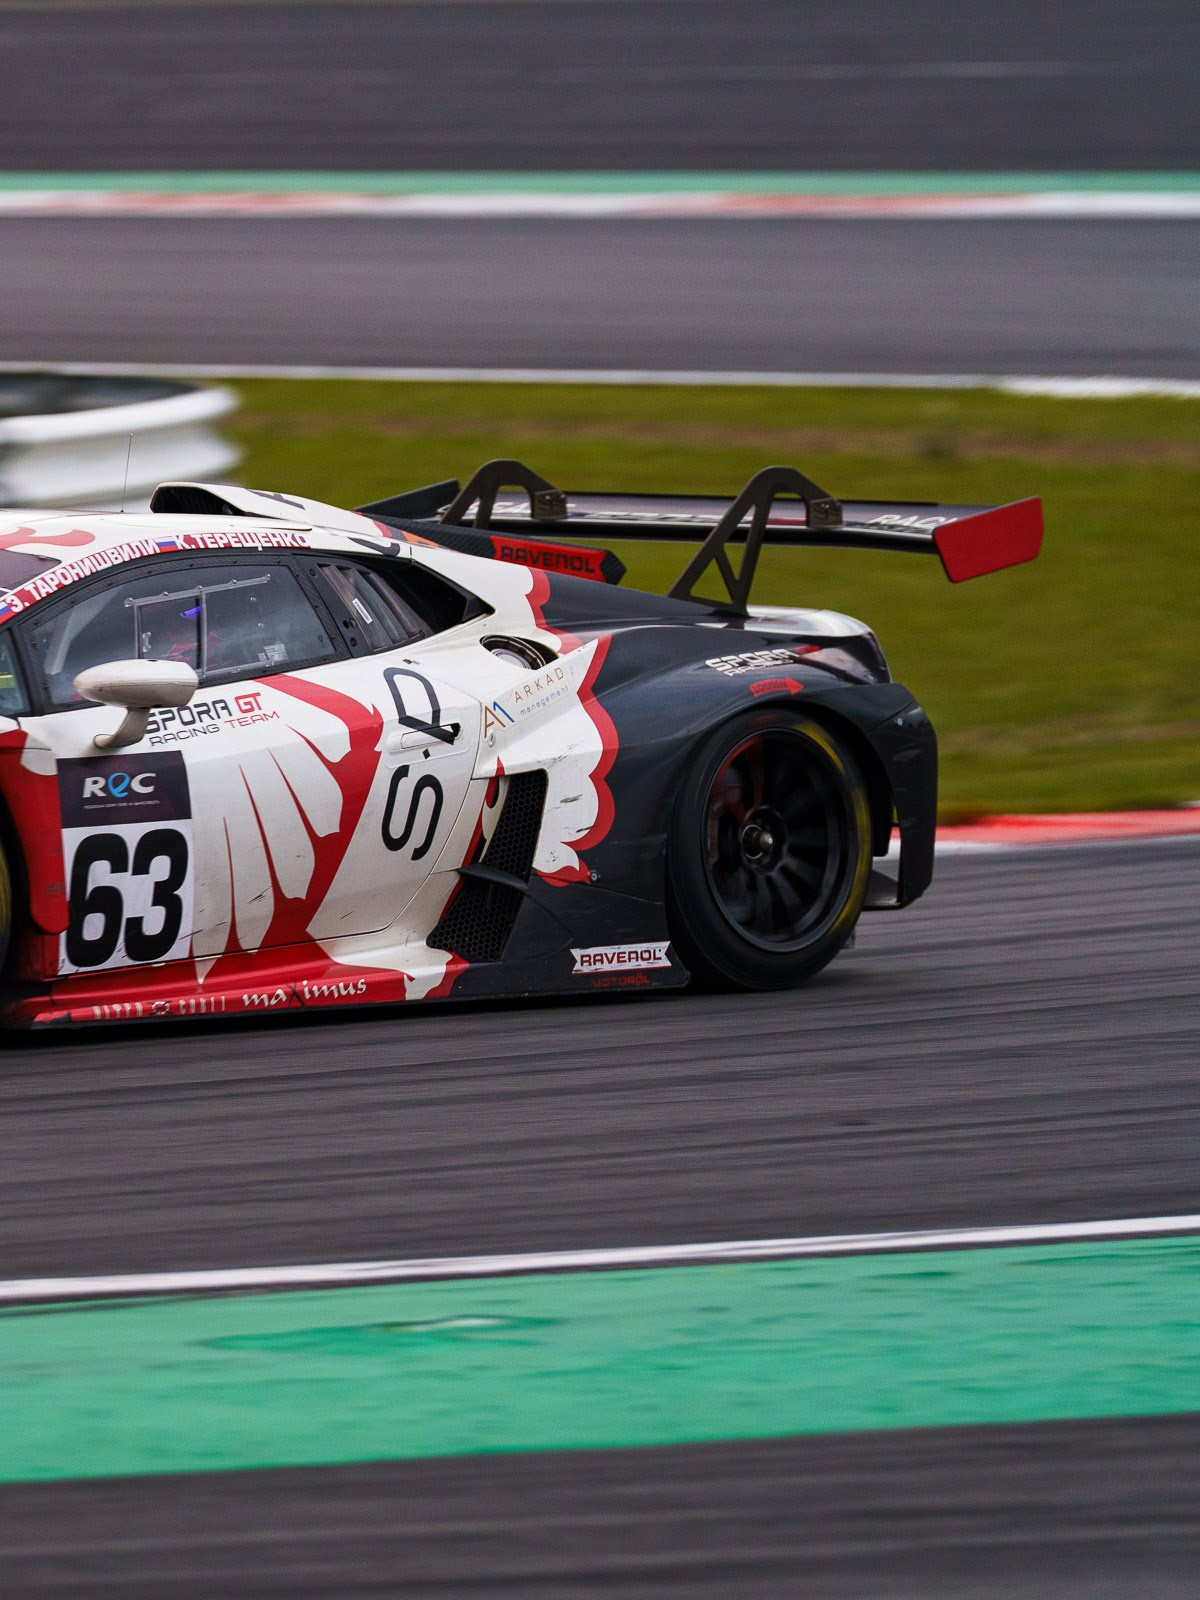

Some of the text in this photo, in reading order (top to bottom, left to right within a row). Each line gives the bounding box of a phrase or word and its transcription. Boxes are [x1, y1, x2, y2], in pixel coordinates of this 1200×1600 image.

[25, 538, 161, 601] ТАРОНИШВИЛИ
[176, 532, 309, 551] К.ТЕРЕЩЕНКО
[500, 545, 596, 574] RAVENOL
[705, 649, 800, 672] SPORA
[515, 667, 564, 703] ARKAD
[519, 685, 569, 716] management
[146, 692, 262, 734] SPORA GT
[149, 711, 280, 746] RACING TEAM
[65, 828, 189, 967] 63
[580, 949, 662, 967] RAVENOL
